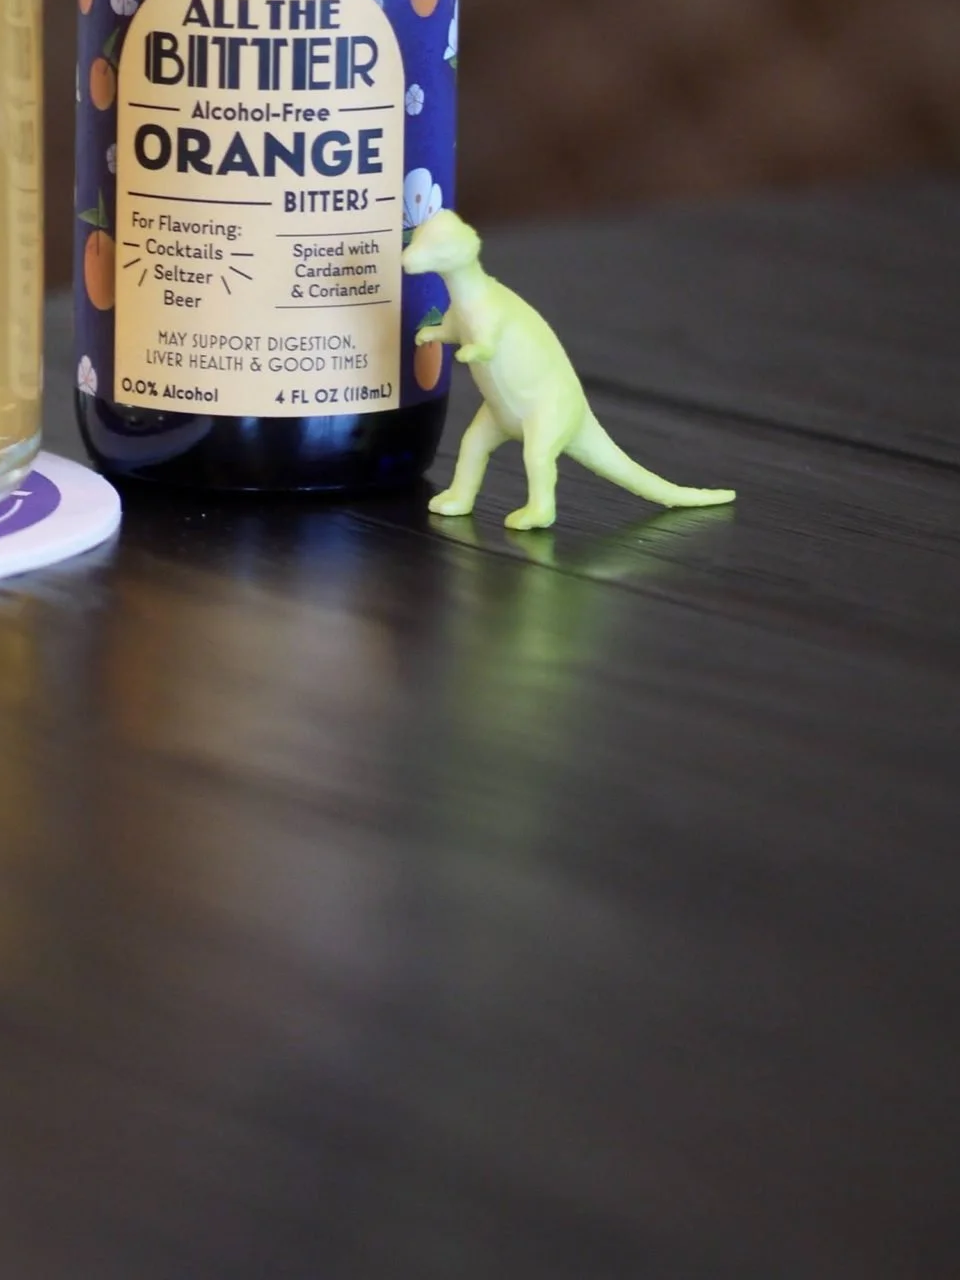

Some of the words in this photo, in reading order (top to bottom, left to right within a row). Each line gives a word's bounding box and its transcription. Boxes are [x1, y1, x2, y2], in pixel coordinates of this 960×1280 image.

[144, 31, 378, 91] BITTER
[191, 100, 330, 122] Alcohol-Free
[134, 123, 383, 177] ORANGE
[284, 188, 368, 212] BITTERS
[131, 211, 154, 229] For
[158, 215, 242, 241] Flavoring:
[145, 238, 224, 260] Cocktails
[293, 241, 344, 261] Spiced
[348, 239, 380, 255] with
[153, 263, 213, 284] Seltzer
[295, 262, 377, 278] Cardamom
[163, 289, 202, 308] Beer
[291, 284, 303, 298] &
[308, 280, 381, 298] Coriander
[158, 330, 187, 346] MAY
[192, 333, 261, 351] SUPPORT
[146, 349, 183, 367] LIVER
[189, 353, 243, 371] HEALTH
[250, 357, 262, 372] &
[268, 356, 325, 372] GOOD
[331, 353, 368, 371] TIMES
[121, 377, 158, 397] 0.0%
[162, 384, 218, 402] Alcohol
[275, 389, 285, 405] 4
[291, 389, 309, 404] FL
[314, 388, 339, 403] OZ
[343, 382, 392, 402] (118mL)
